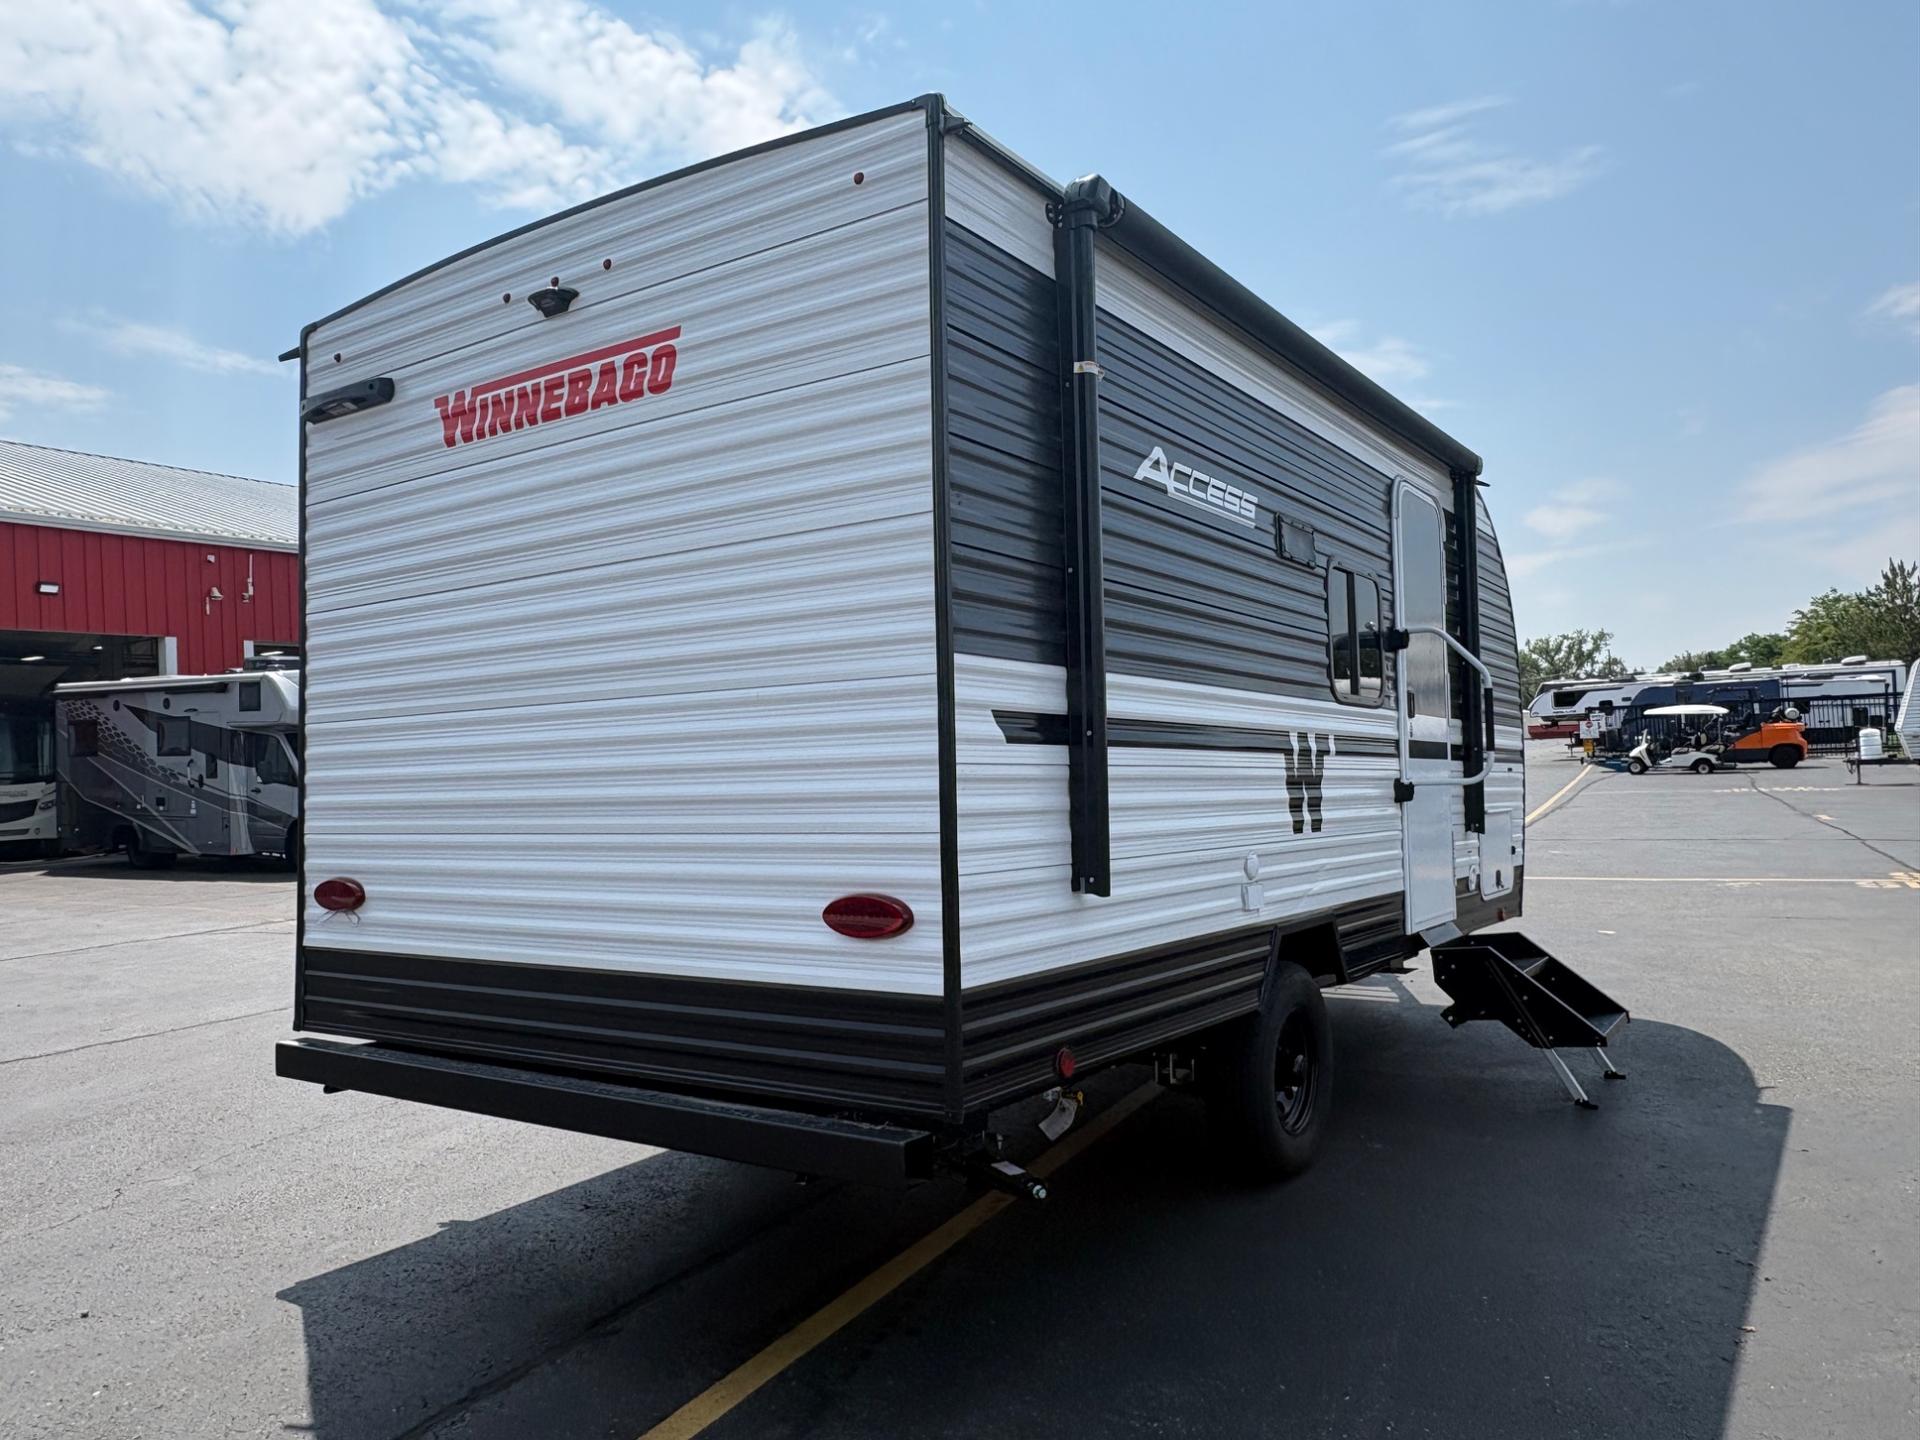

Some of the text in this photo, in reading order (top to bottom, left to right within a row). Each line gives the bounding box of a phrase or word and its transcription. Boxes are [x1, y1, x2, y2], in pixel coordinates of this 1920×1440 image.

[434, 336, 679, 448] WINNEBAGO
[1134, 446, 1259, 522] ACCESS
[1283, 731, 1335, 834] W
